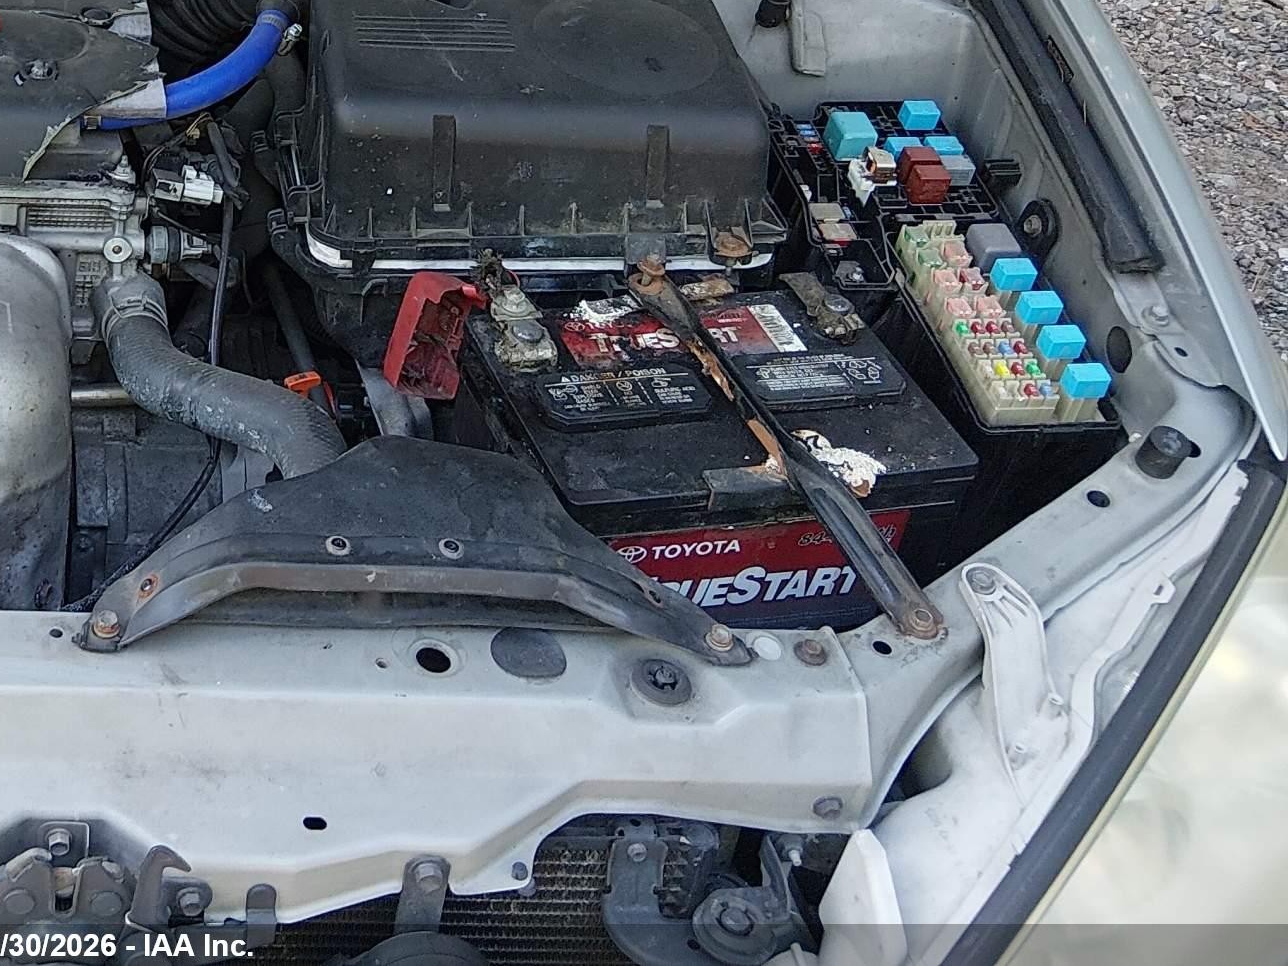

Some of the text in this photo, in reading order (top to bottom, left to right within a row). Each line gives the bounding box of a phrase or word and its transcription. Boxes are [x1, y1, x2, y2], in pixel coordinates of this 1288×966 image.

[624, 367, 667, 377] POISON
[652, 539, 741, 560] TOYOTA
[656, 566, 857, 608] UESTART
